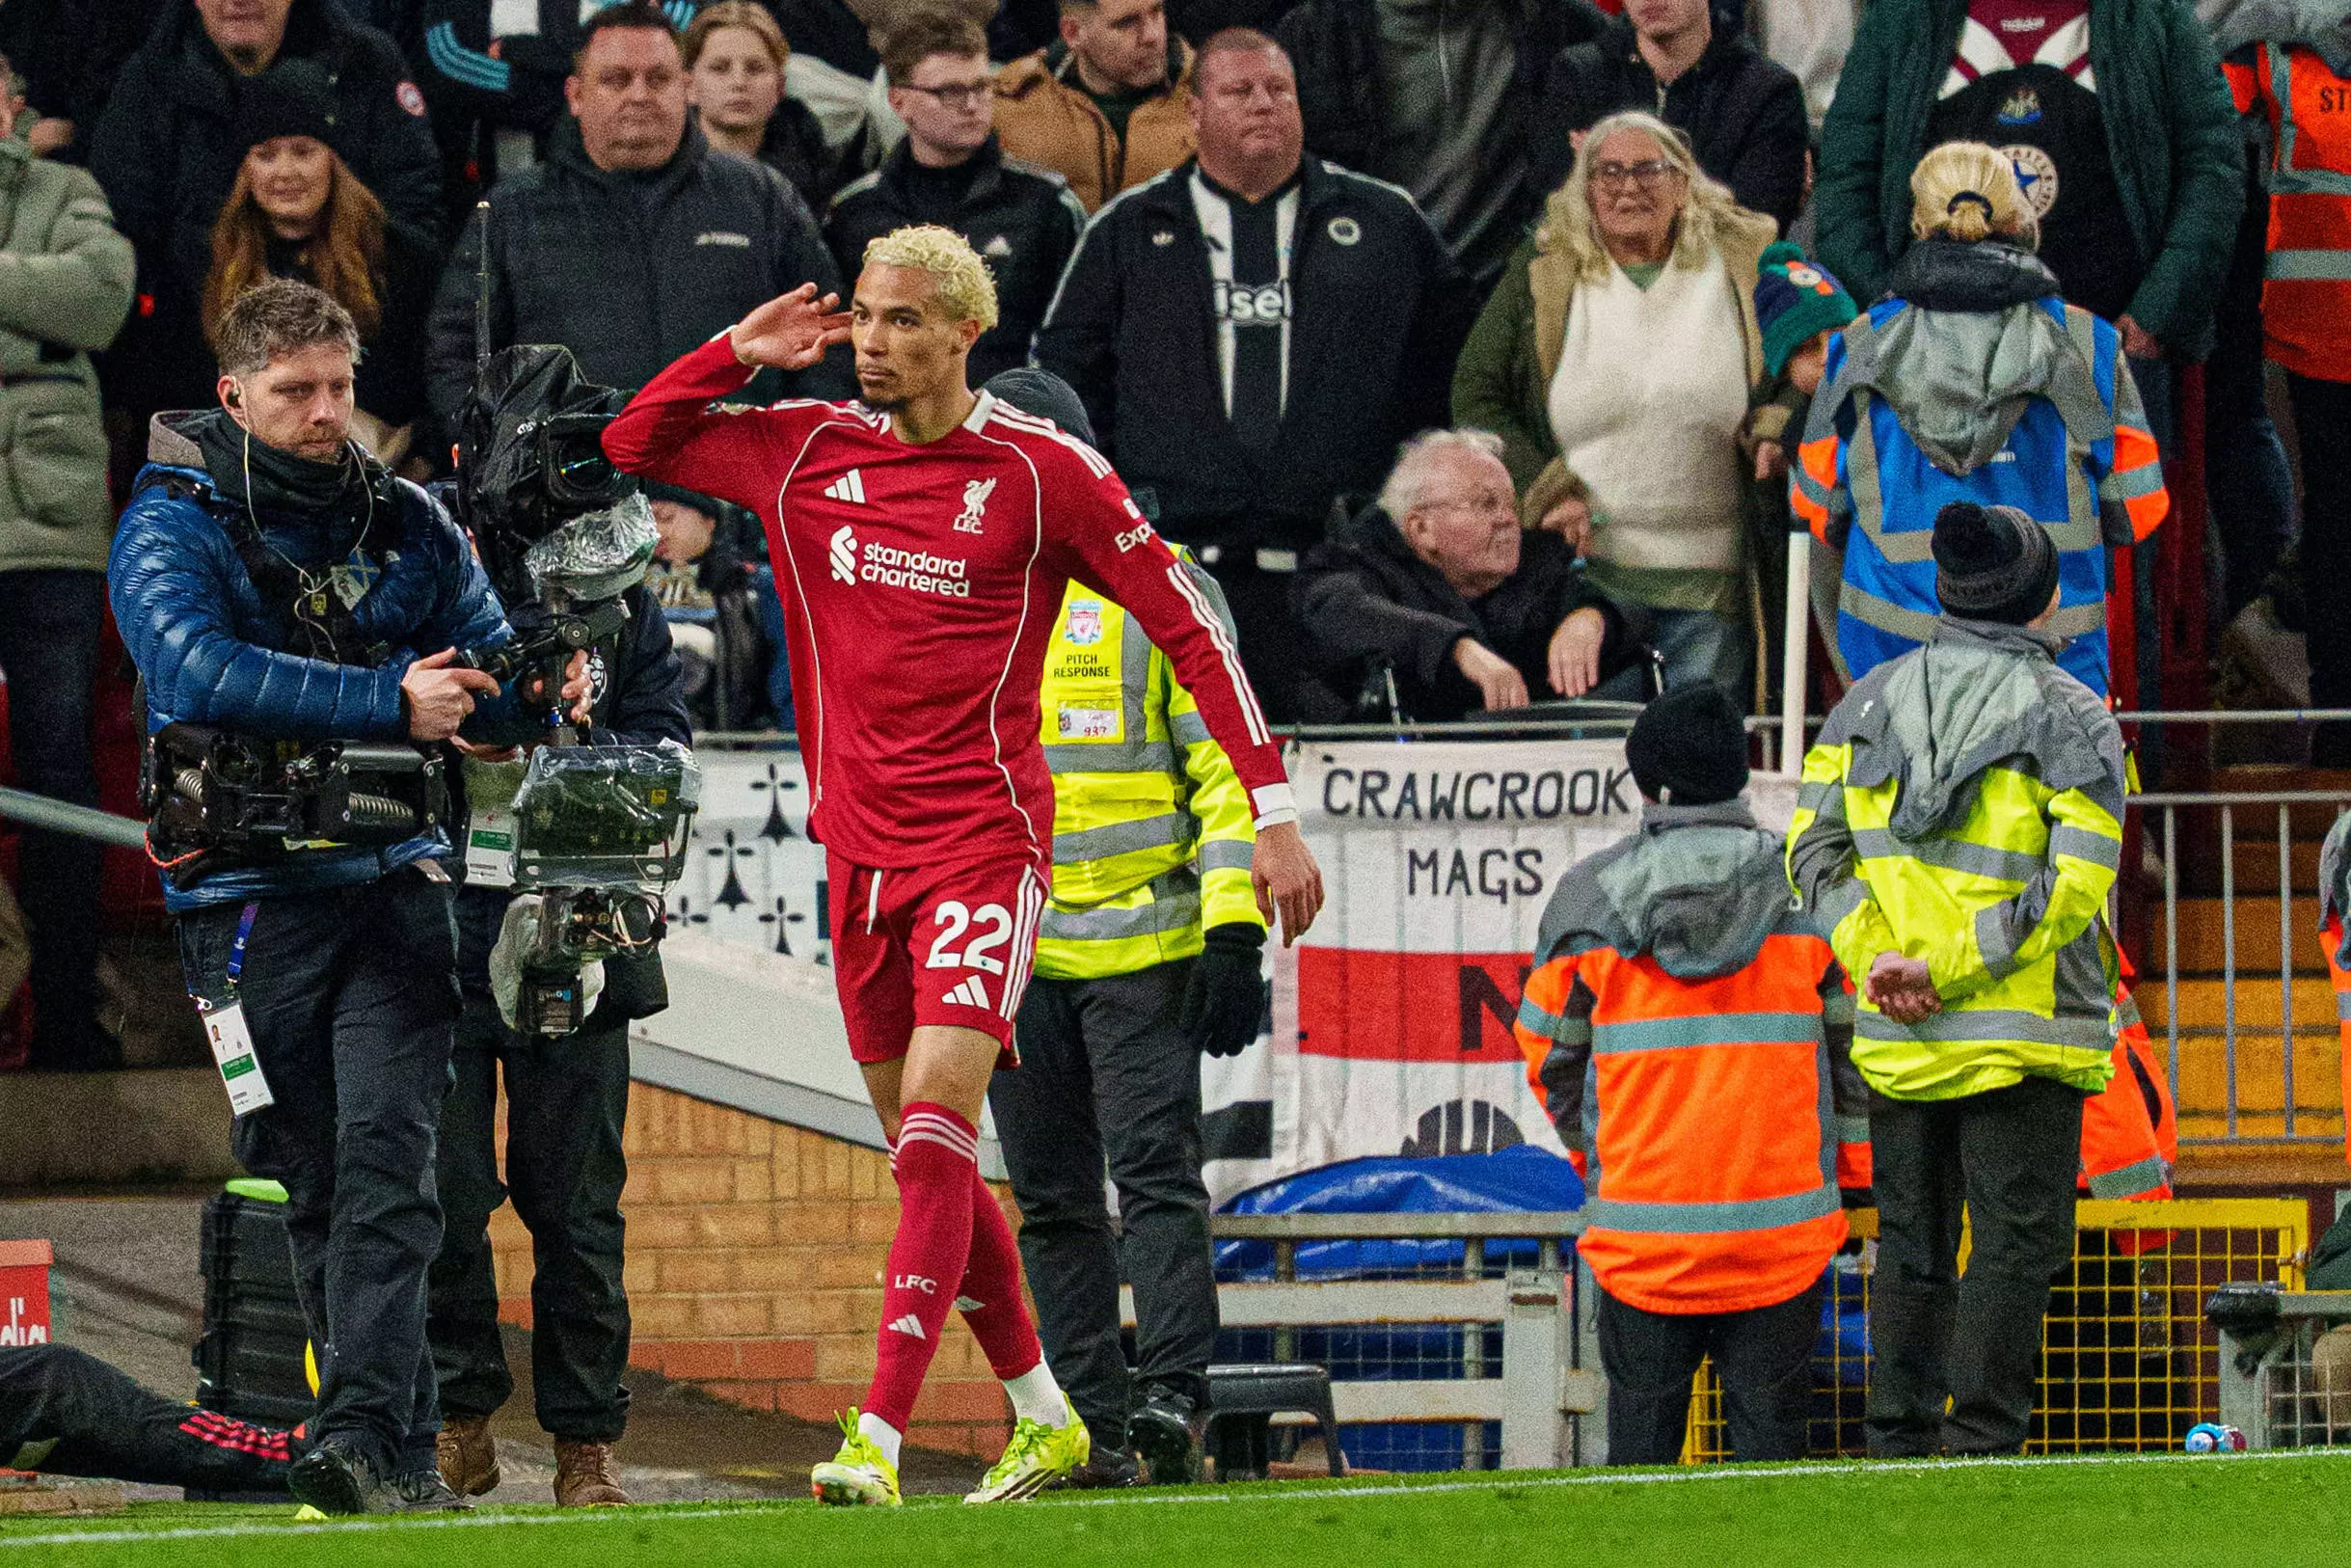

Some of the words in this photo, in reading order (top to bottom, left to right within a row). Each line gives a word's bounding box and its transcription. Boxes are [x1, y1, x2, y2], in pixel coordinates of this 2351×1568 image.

[953, 515, 984, 534] LFC
[1115, 521, 1155, 553] Exp
[863, 542, 966, 579] standard
[860, 563, 970, 597] chartered
[1053, 666, 1111, 678] RESPONSE
[1067, 654, 1097, 664] PITCH
[1323, 769, 1632, 822] CRAWCROOK
[1408, 848, 1543, 905] MAGS
[925, 900, 1013, 976] 22
[895, 1274, 937, 1295] LFC
